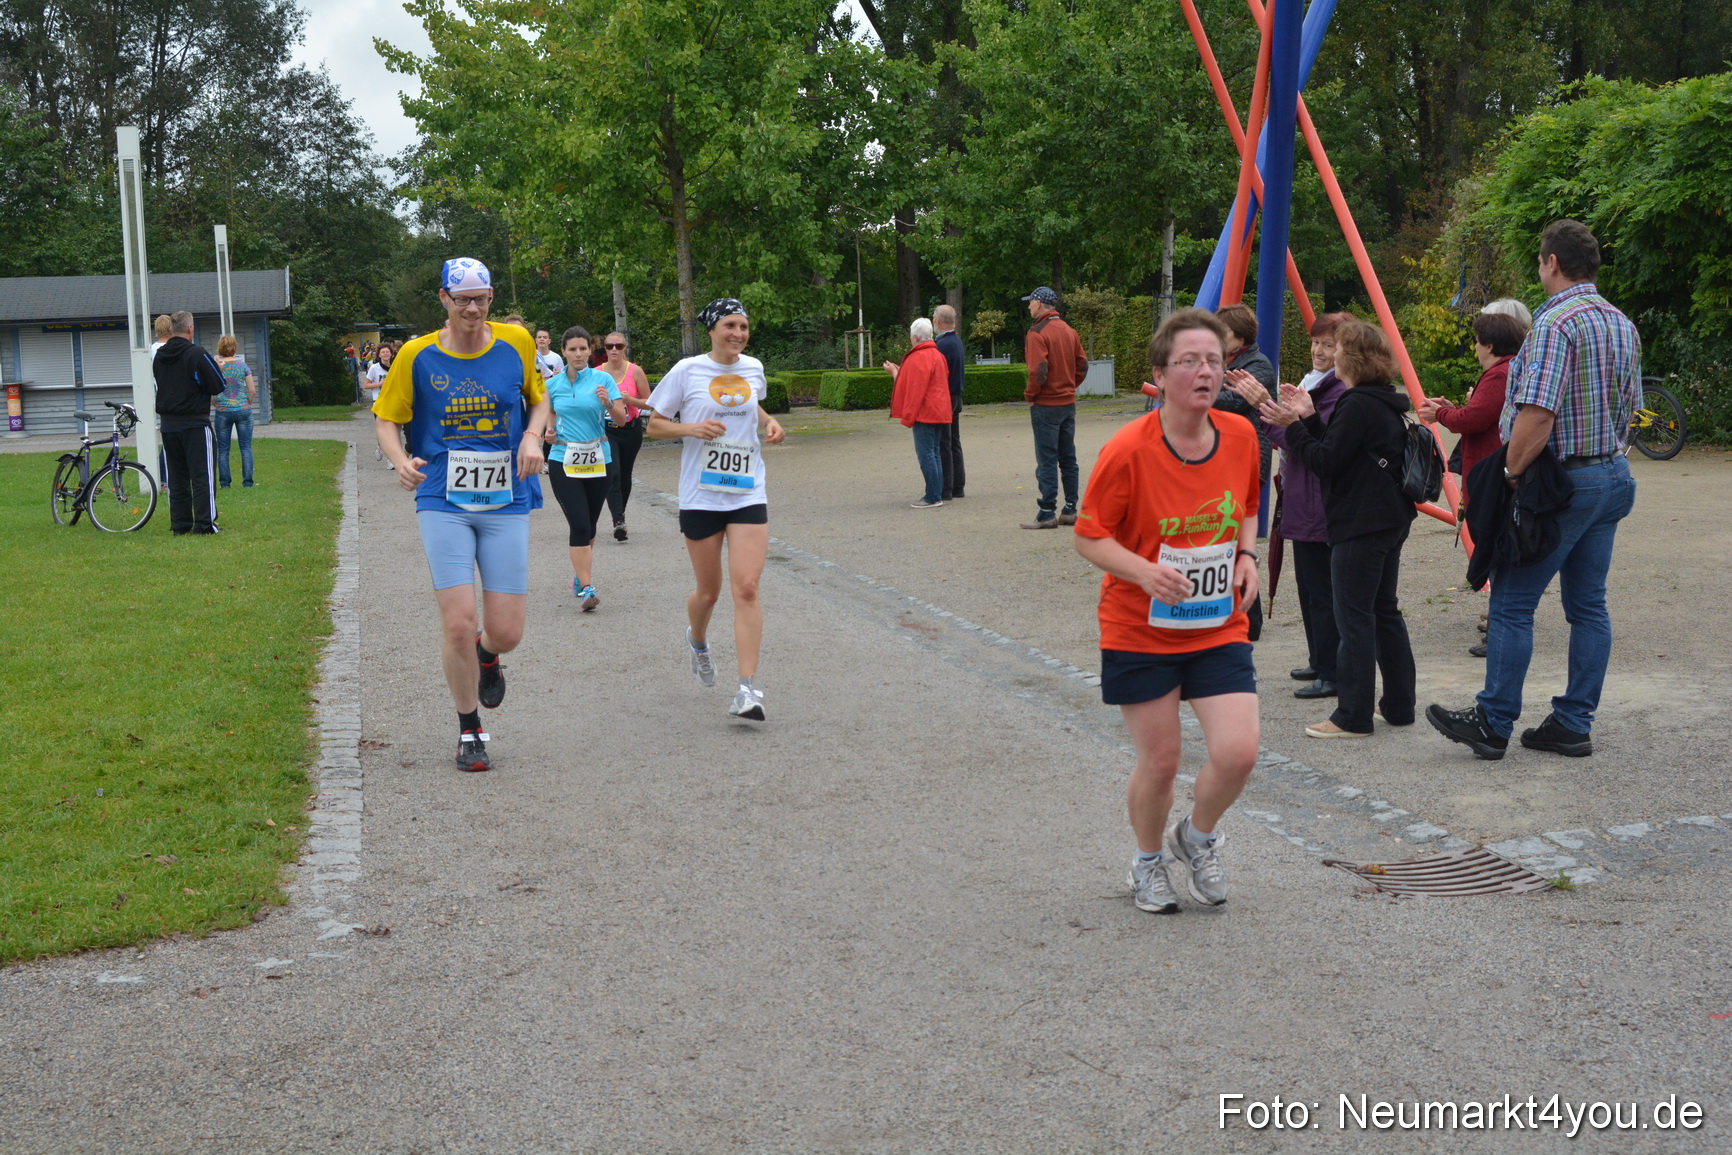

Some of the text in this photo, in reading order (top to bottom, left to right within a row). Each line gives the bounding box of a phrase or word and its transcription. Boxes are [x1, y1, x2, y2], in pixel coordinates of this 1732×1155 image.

[725, 444, 748, 452] Neumarkt
[572, 452, 598, 464] 278
[707, 450, 750, 474] 2091
[454, 466, 506, 488] 2174
[719, 476, 738, 486] Julia
[471, 494, 490, 504] Jörg
[1183, 522, 1221, 534] FunRun
[1160, 552, 1224, 564] PARTL Neumarkt
[1175, 564, 1228, 598] 509
[1170, 605, 1219, 618] Christine
